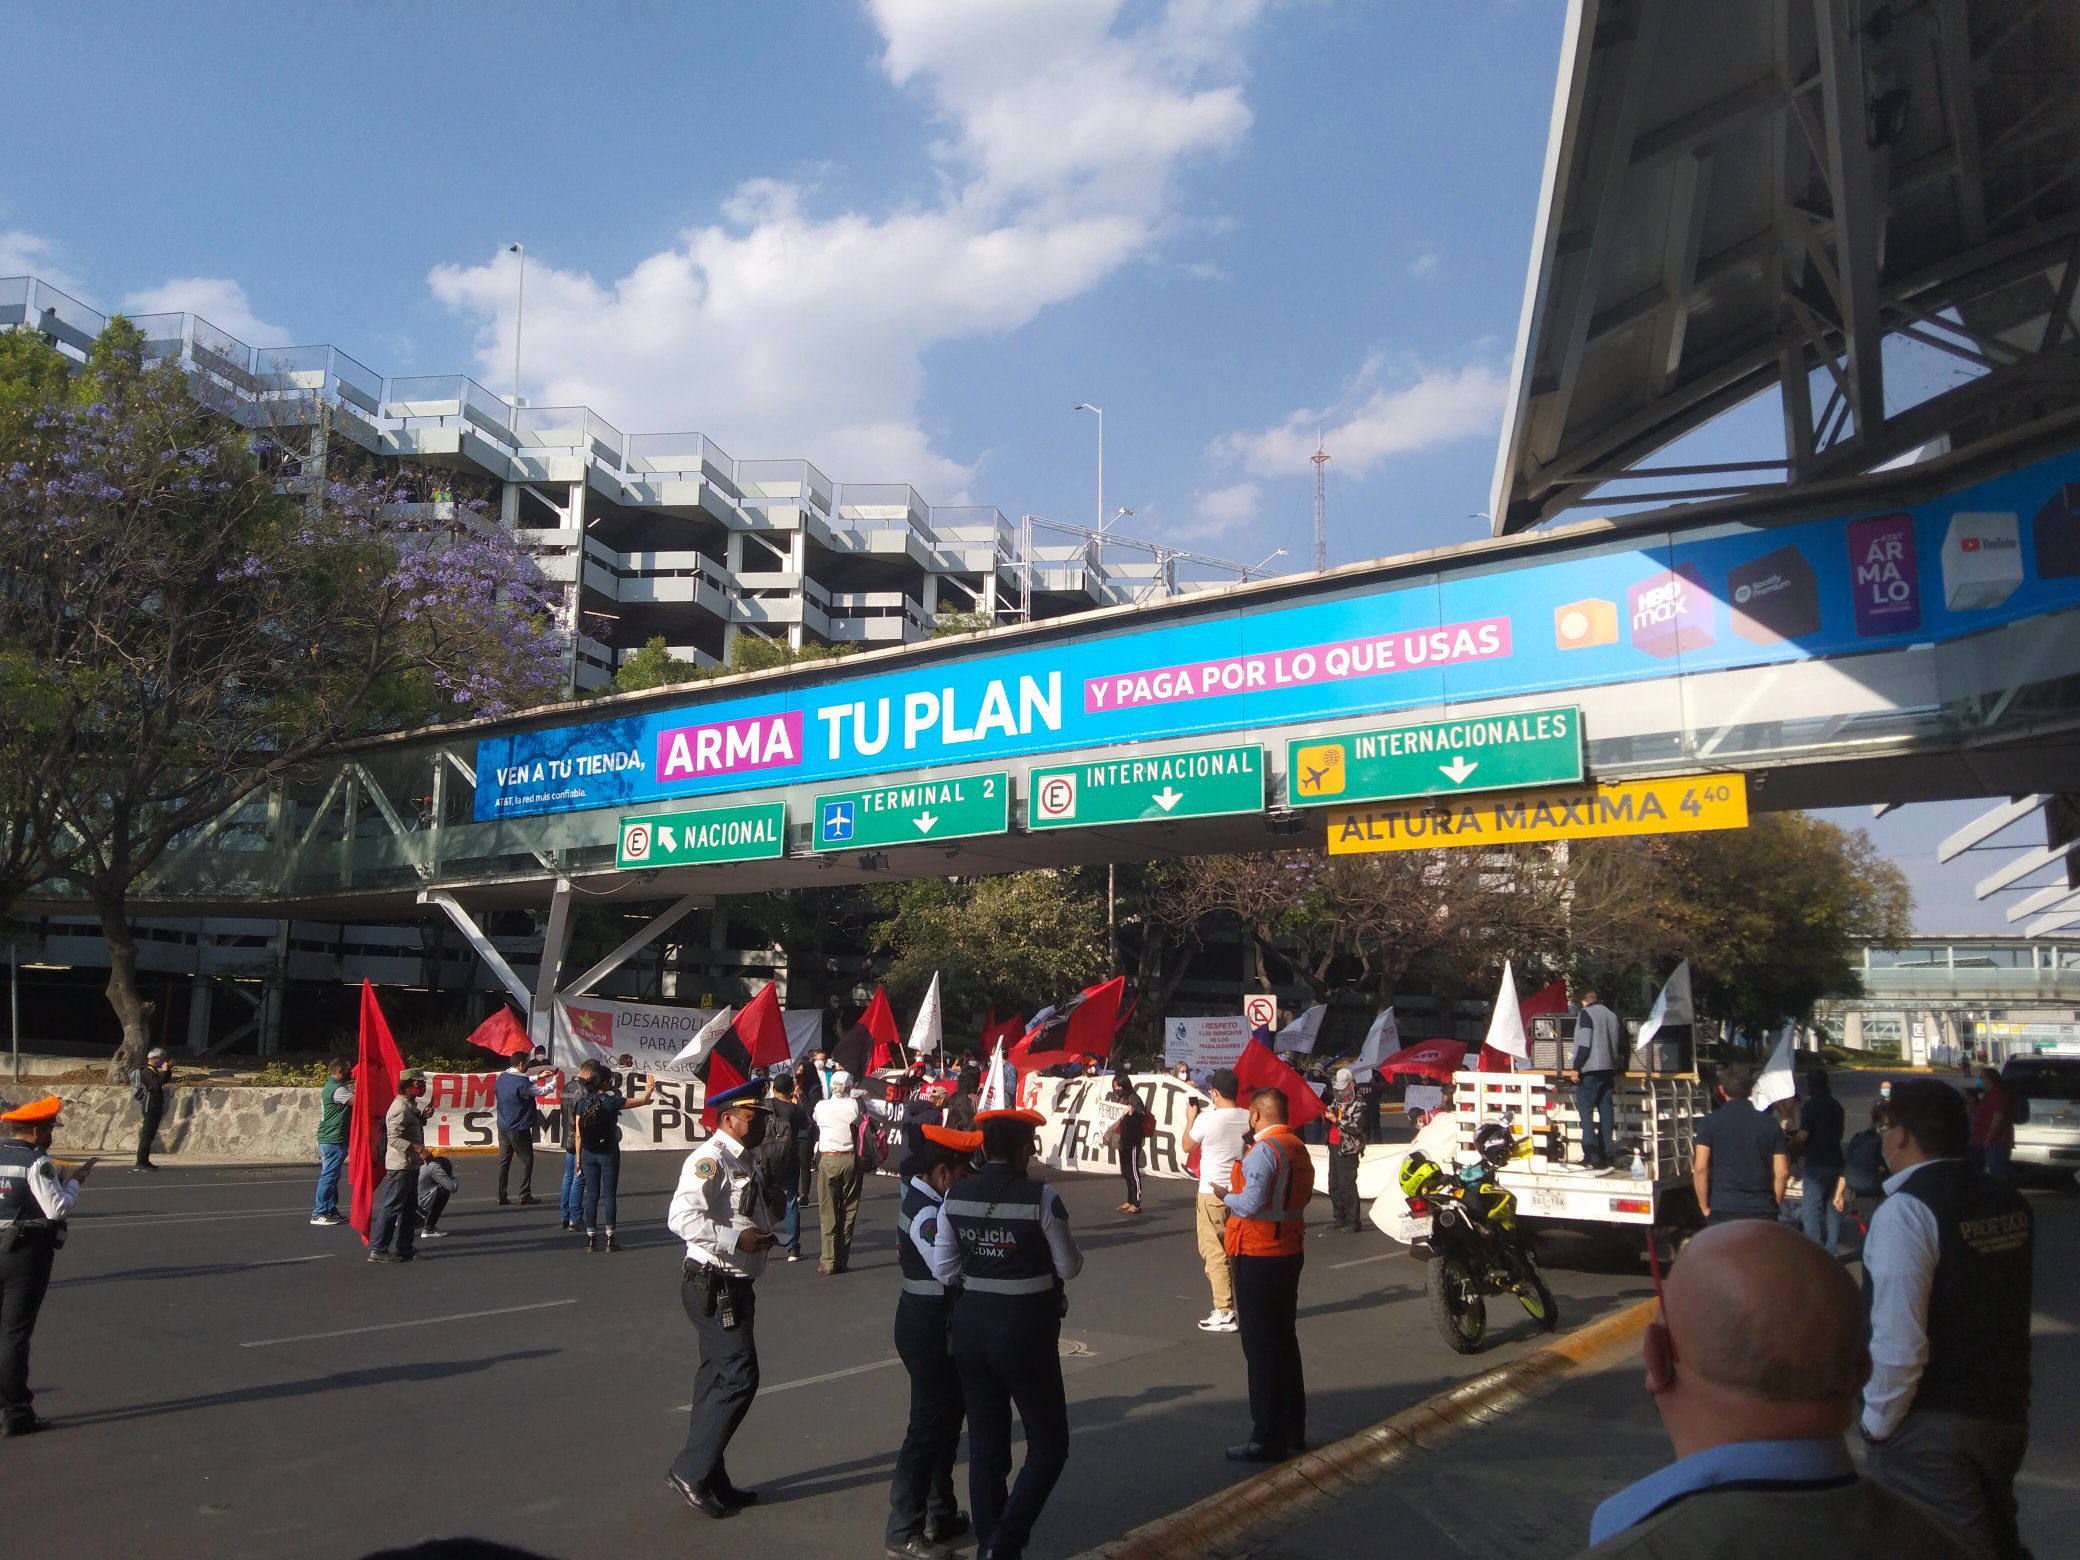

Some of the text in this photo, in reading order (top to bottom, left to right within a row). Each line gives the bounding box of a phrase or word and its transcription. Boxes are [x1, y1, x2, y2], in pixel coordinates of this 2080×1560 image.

[1982, 537, 2017, 550] YouTube
[1752, 574, 1782, 589] Spotify
[1857, 562, 1902, 585] MA
[1638, 581, 1682, 613] HBO
[1752, 580, 1791, 599] Premium
[1873, 581, 1910, 604] LO
[1633, 595, 1689, 631] max
[1091, 625, 1500, 708] Y PAGA POR LO QUE USAS
[818, 671, 1062, 760] TU PLAN
[664, 718, 794, 776] ARMA
[1355, 714, 1567, 760] INTERNACIONALES
[497, 749, 645, 786] VEN A TU TIENDA,
[1087, 752, 1253, 788] INTERNACIONAL
[515, 795, 521, 805] la
[522, 793, 534, 803] red
[536, 792, 550, 803] más
[552, 788, 586, 800] confiable.
[862, 778, 995, 813] TERMINAL 2
[1340, 805, 1483, 843] ALTURA
[1495, 792, 1668, 832] MAXIMA
[684, 818, 777, 849] NACIONAL
[616, 1012, 712, 1034] ¡DESARROLL
[640, 1036, 677, 1052] PARA
[958, 1226, 1017, 1245] POLICÍA
